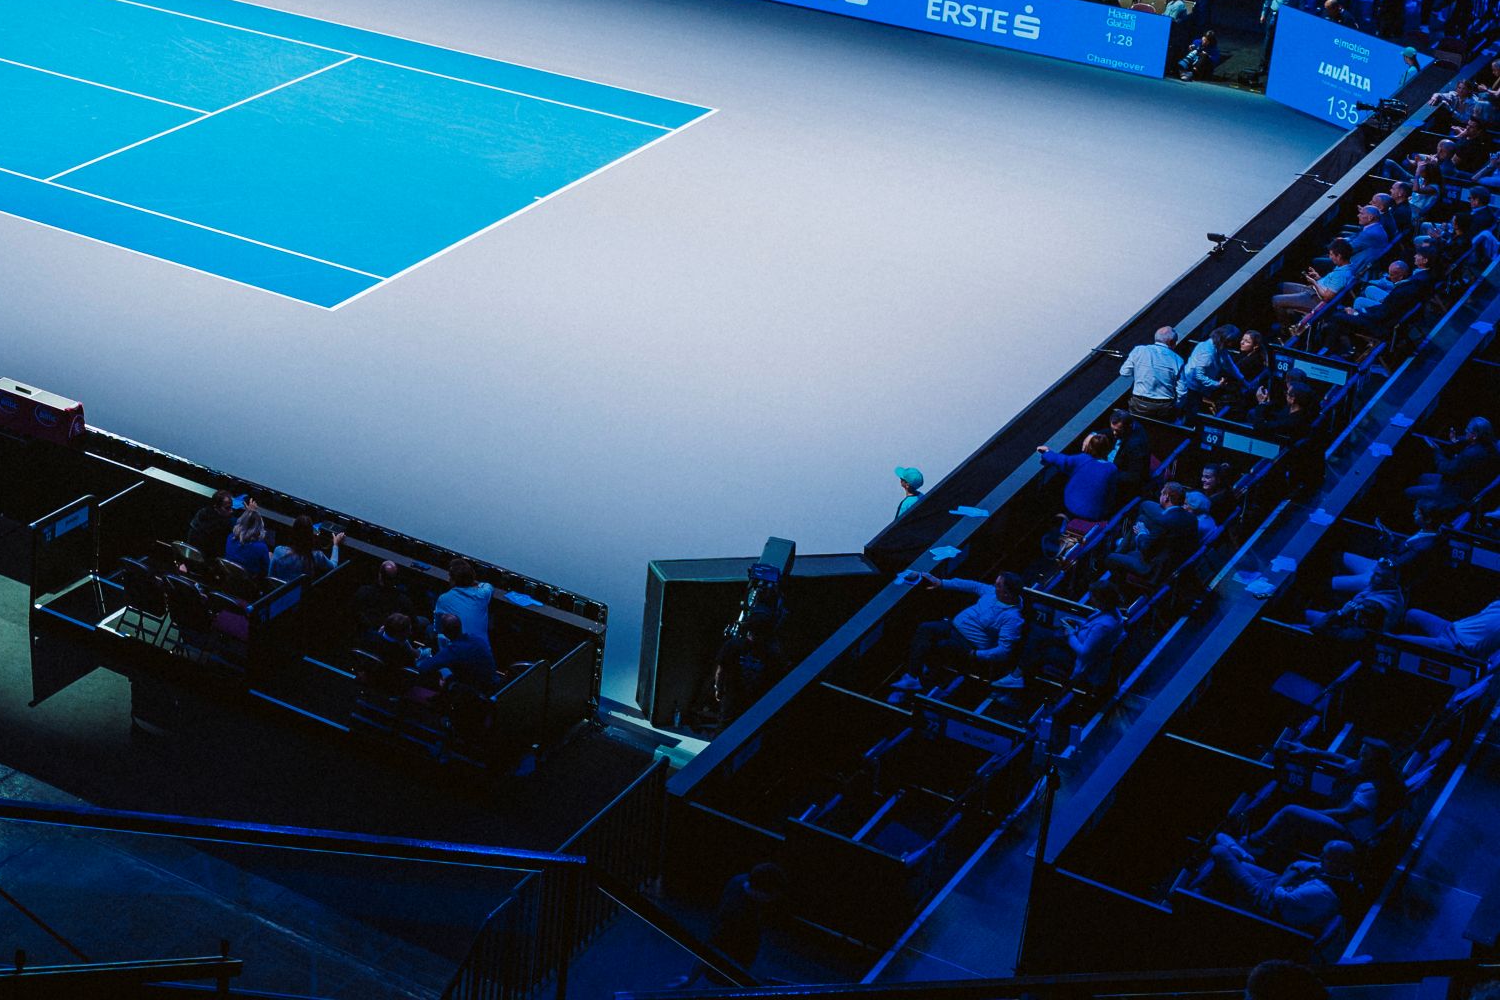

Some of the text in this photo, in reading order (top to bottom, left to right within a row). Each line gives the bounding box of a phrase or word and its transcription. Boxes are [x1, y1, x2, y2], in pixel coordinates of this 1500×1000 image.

[1105, 32, 1133, 47] 1:28
[1087, 54, 1145, 71] Changeover
[1318, 62, 1371, 92] LAVAZZA
[1327, 96, 1359, 124] 135
[1277, 361, 1289, 371] 68
[1206, 434, 1218, 444] 69
